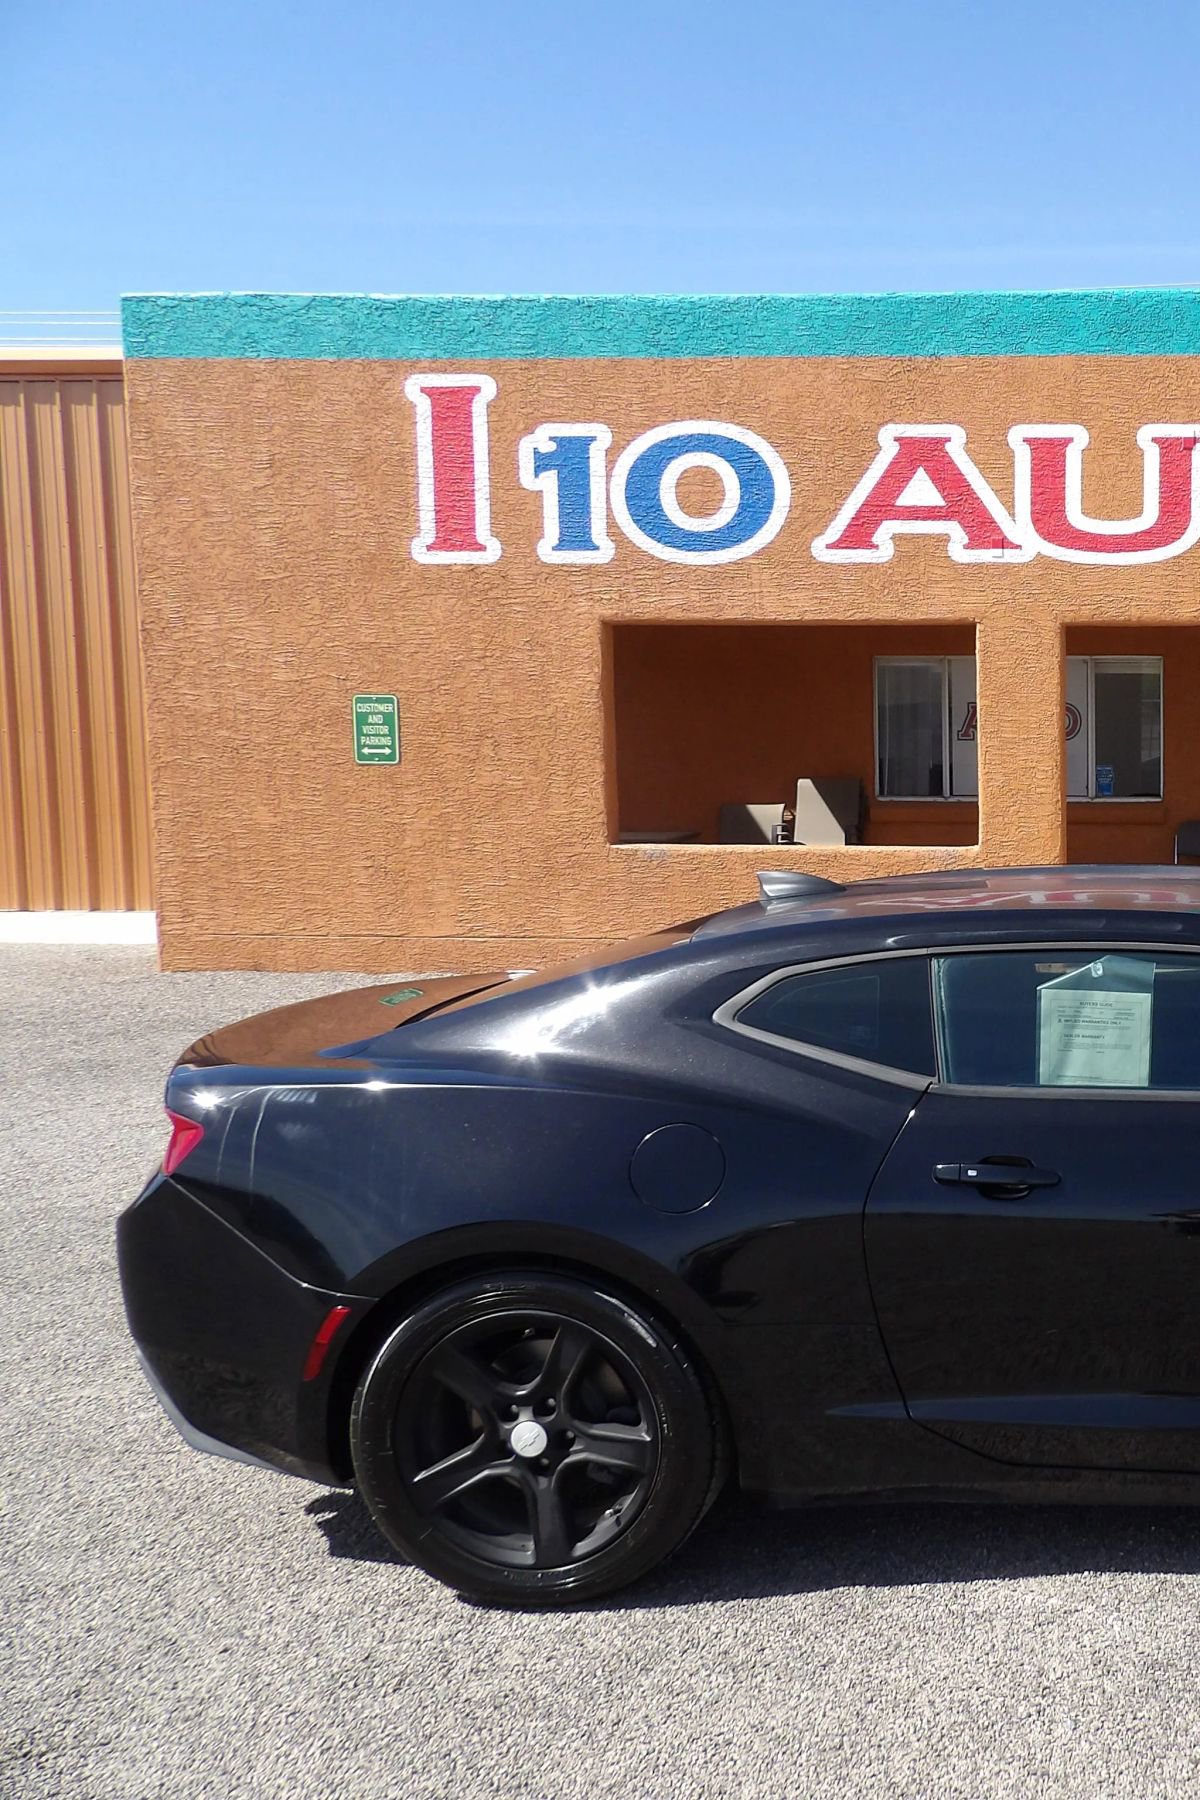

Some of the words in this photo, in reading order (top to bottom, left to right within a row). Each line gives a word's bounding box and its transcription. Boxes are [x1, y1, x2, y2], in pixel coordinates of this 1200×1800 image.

[357, 703, 393, 712] CUSTOMER
[368, 715, 383, 723] AND
[361, 725, 389, 734] VISITOR
[360, 736, 392, 745] PARKING
